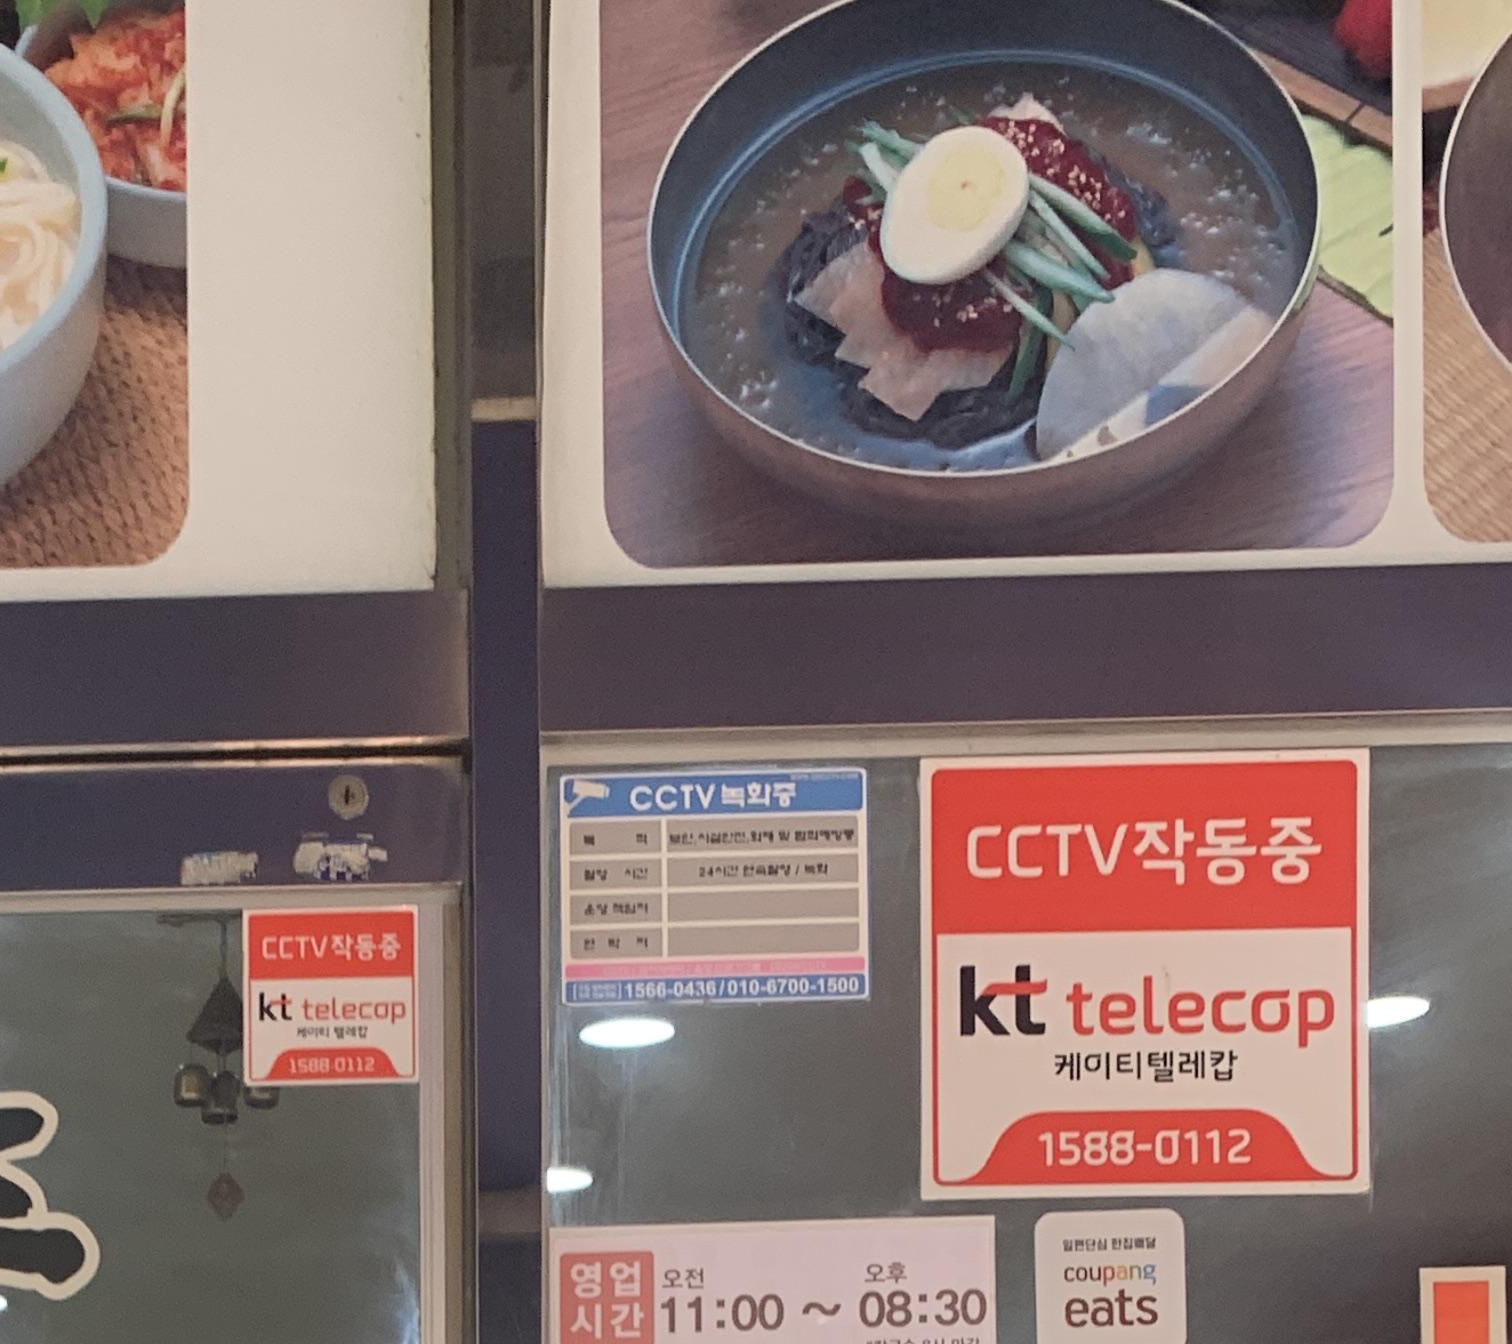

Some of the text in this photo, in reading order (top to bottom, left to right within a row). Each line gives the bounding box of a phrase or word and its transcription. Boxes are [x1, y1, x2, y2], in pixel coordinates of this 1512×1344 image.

[258, 991, 407, 1025] kt telecop
[959, 964, 1335, 1049] kt telecop
[1038, 1128, 1252, 1167] 1588-0112
[570, 1260, 642, 1299] 영업
[661, 1267, 704, 1291] 오전
[864, 1260, 908, 1285] 오후
[1063, 1264, 1157, 1288] coupang
[570, 1301, 645, 1341] 시간
[659, 1292, 784, 1334] 11:00
[858, 1287, 987, 1329] 08:30
[1064, 1288, 1159, 1328] eats
